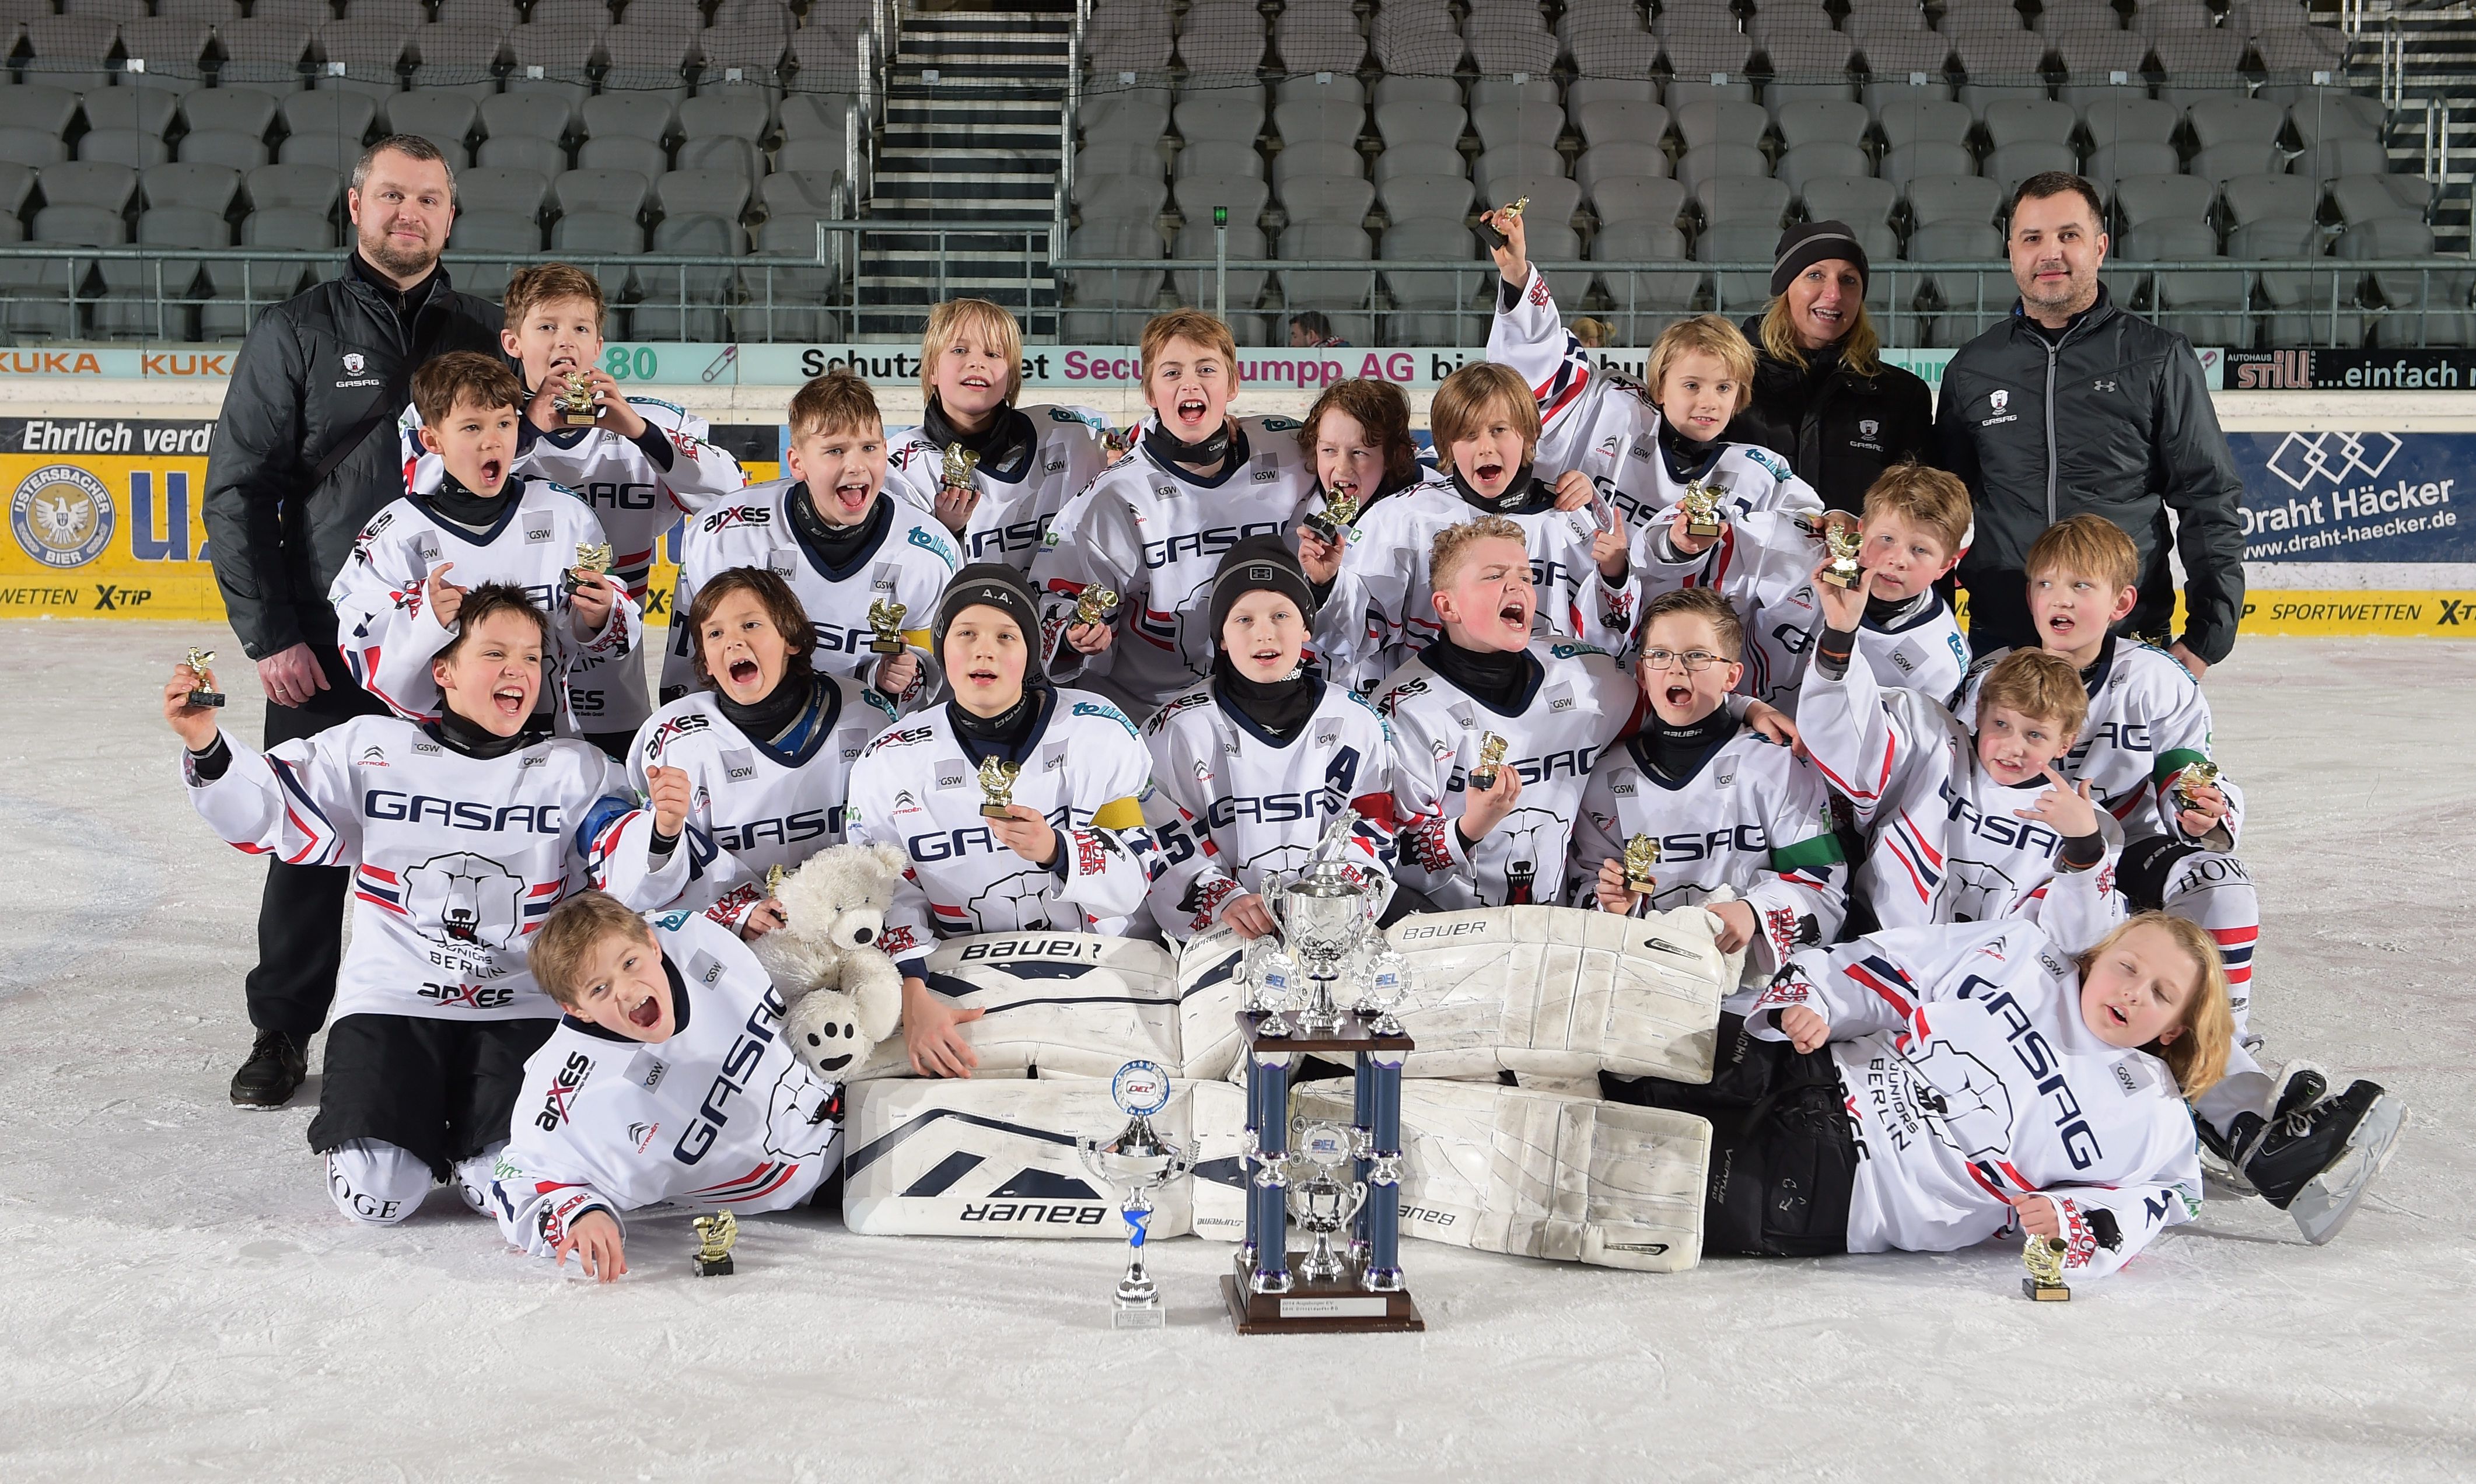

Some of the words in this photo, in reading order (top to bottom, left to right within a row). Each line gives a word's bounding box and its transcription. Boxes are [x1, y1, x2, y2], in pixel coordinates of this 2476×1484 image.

[2227, 354, 2272, 362] AUTOHAUS
[1359, 352, 1414, 381] AG
[336, 379, 380, 388] GASAG
[1982, 414, 2017, 426] GASAG
[22, 421, 132, 453] Ehrlich
[1634, 446, 1650, 460] GSW
[1047, 460, 1065, 471] GSW
[1254, 470, 1276, 480] GSW
[14, 468, 110, 514] USTERSBACHER
[1158, 485, 1177, 496] GSW
[2237, 495, 2325, 536] Draht
[2331, 479, 2454, 521] Häcker
[528, 528, 551, 540] GSW
[1571, 522, 1589, 541] GSW
[45, 550, 82, 565] BIER
[772, 566, 793, 576] GSW
[875, 580, 895, 590] GSW
[982, 589, 1013, 605] A.A.
[2270, 604, 2422, 621] SPORTWETTEN
[1894, 651, 1914, 671] GSW
[1553, 697, 1573, 708] GSW
[416, 743, 440, 752] GSW
[524, 757, 546, 765] GSW
[730, 766, 753, 778] GSW
[940, 775, 963, 786] GSW
[1613, 784, 1635, 794] GSW
[429, 950, 508, 979] BERLIN
[2042, 955, 2065, 977] GSW
[705, 961, 723, 984] GSW
[646, 1061, 664, 1087] GSW
[2117, 1063, 2136, 1091] GSW
[1868, 1058, 1912, 1152] BERLIN
[1889, 1062, 1919, 1135] JUNIORS
